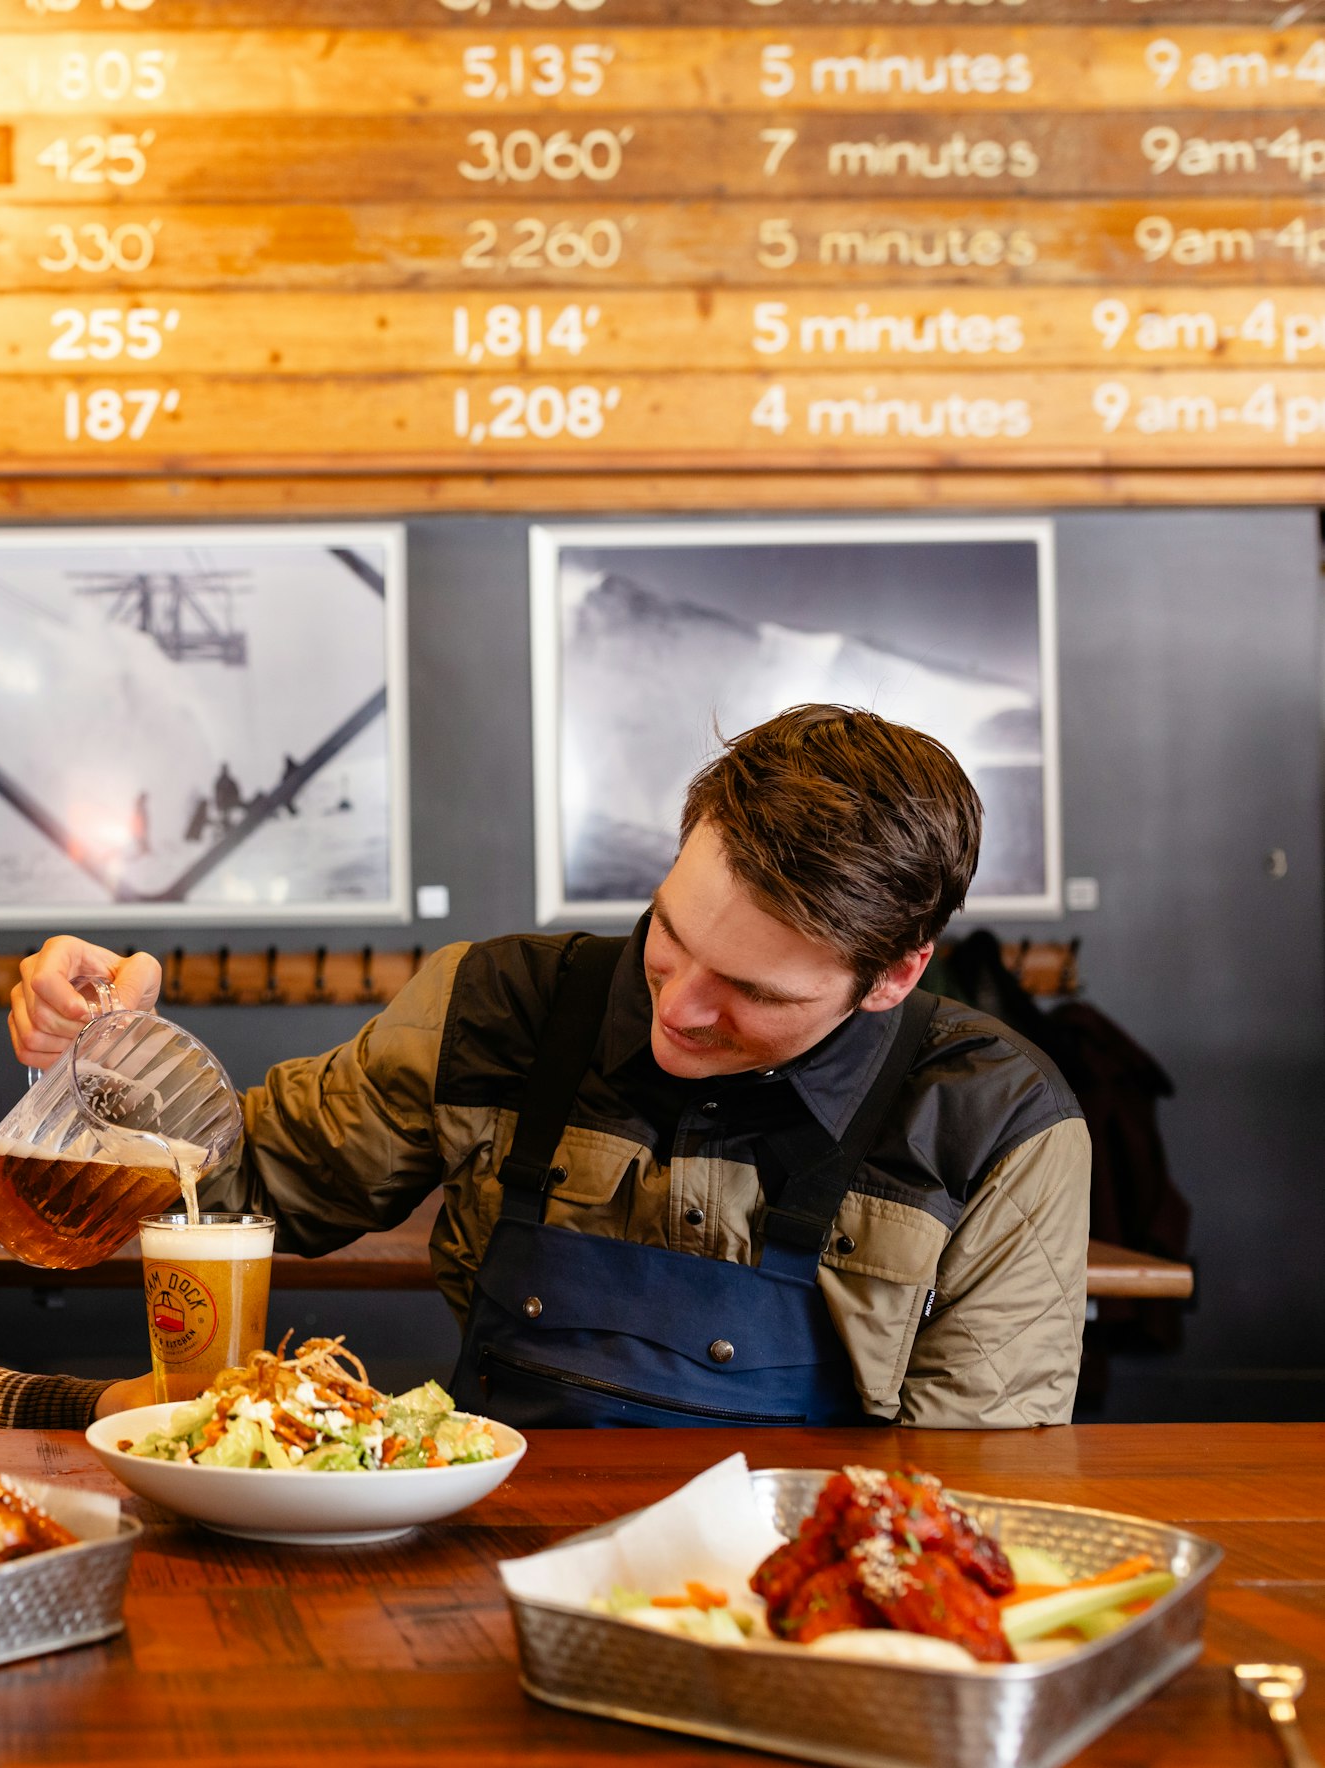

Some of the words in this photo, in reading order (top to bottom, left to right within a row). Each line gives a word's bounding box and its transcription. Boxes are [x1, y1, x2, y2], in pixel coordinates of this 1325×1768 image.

[462, 44, 615, 100] 5,135'
[760, 45, 794, 96] 5
[810, 45, 1034, 94] minutes
[37, 128, 156, 185] 425'
[760, 128, 798, 176] 7
[828, 132, 1039, 178] minutes
[39, 218, 162, 274] 330'
[757, 220, 798, 268] 5
[820, 220, 1036, 267] minutes
[48, 308, 180, 360] 255'
[453, 304, 601, 363] 1,814'
[753, 302, 789, 353] 5
[801, 304, 1024, 353] minutes
[1091, 299, 1325, 363] 9am-4p
[64, 388, 180, 441] 187'
[453, 385, 619, 444] 1,208'
[750, 384, 790, 435] 4
[808, 386, 1032, 438] minutes
[1091, 381, 1325, 447] 9am-4p
[168, 1272, 208, 1310] DOCK
[925, 1291, 935, 1317] FLYLOW
[165, 1328, 197, 1348] KITCHEN
